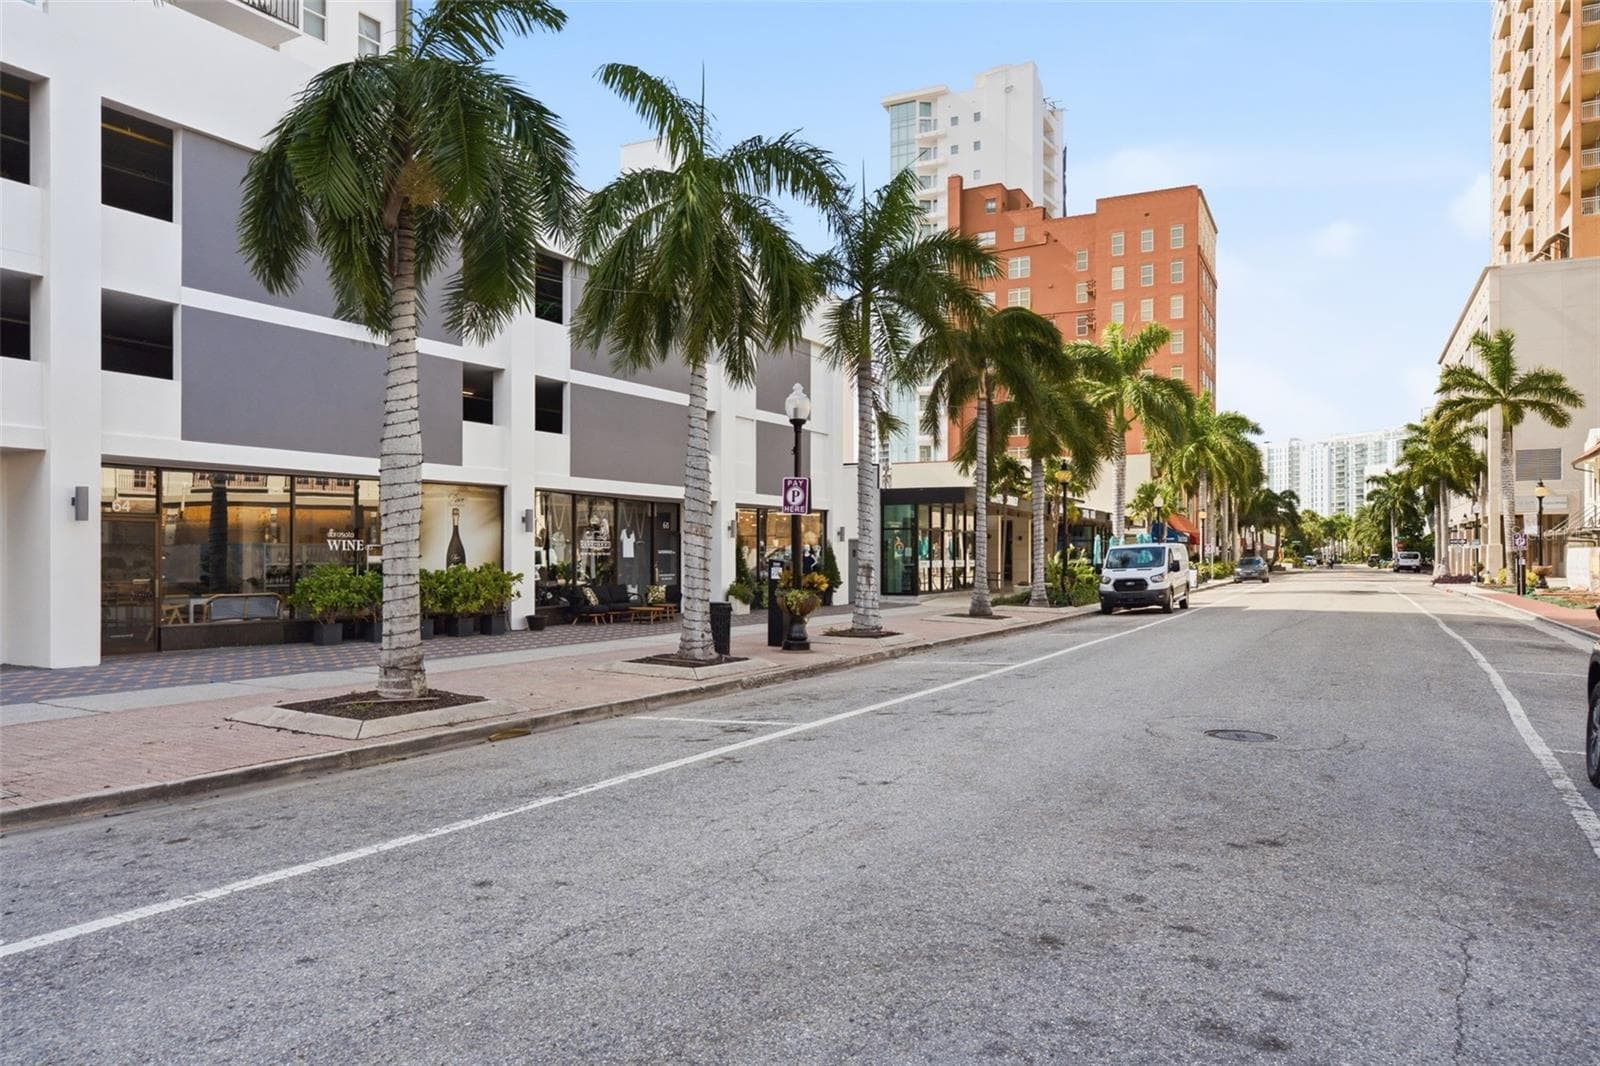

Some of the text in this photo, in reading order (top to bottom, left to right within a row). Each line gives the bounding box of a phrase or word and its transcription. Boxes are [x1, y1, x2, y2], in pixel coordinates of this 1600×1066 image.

[787, 479, 804, 487] PAY
[791, 490, 800, 503] P
[111, 500, 131, 513] 64
[784, 505, 805, 513] HERE
[326, 539, 365, 552] WINE
